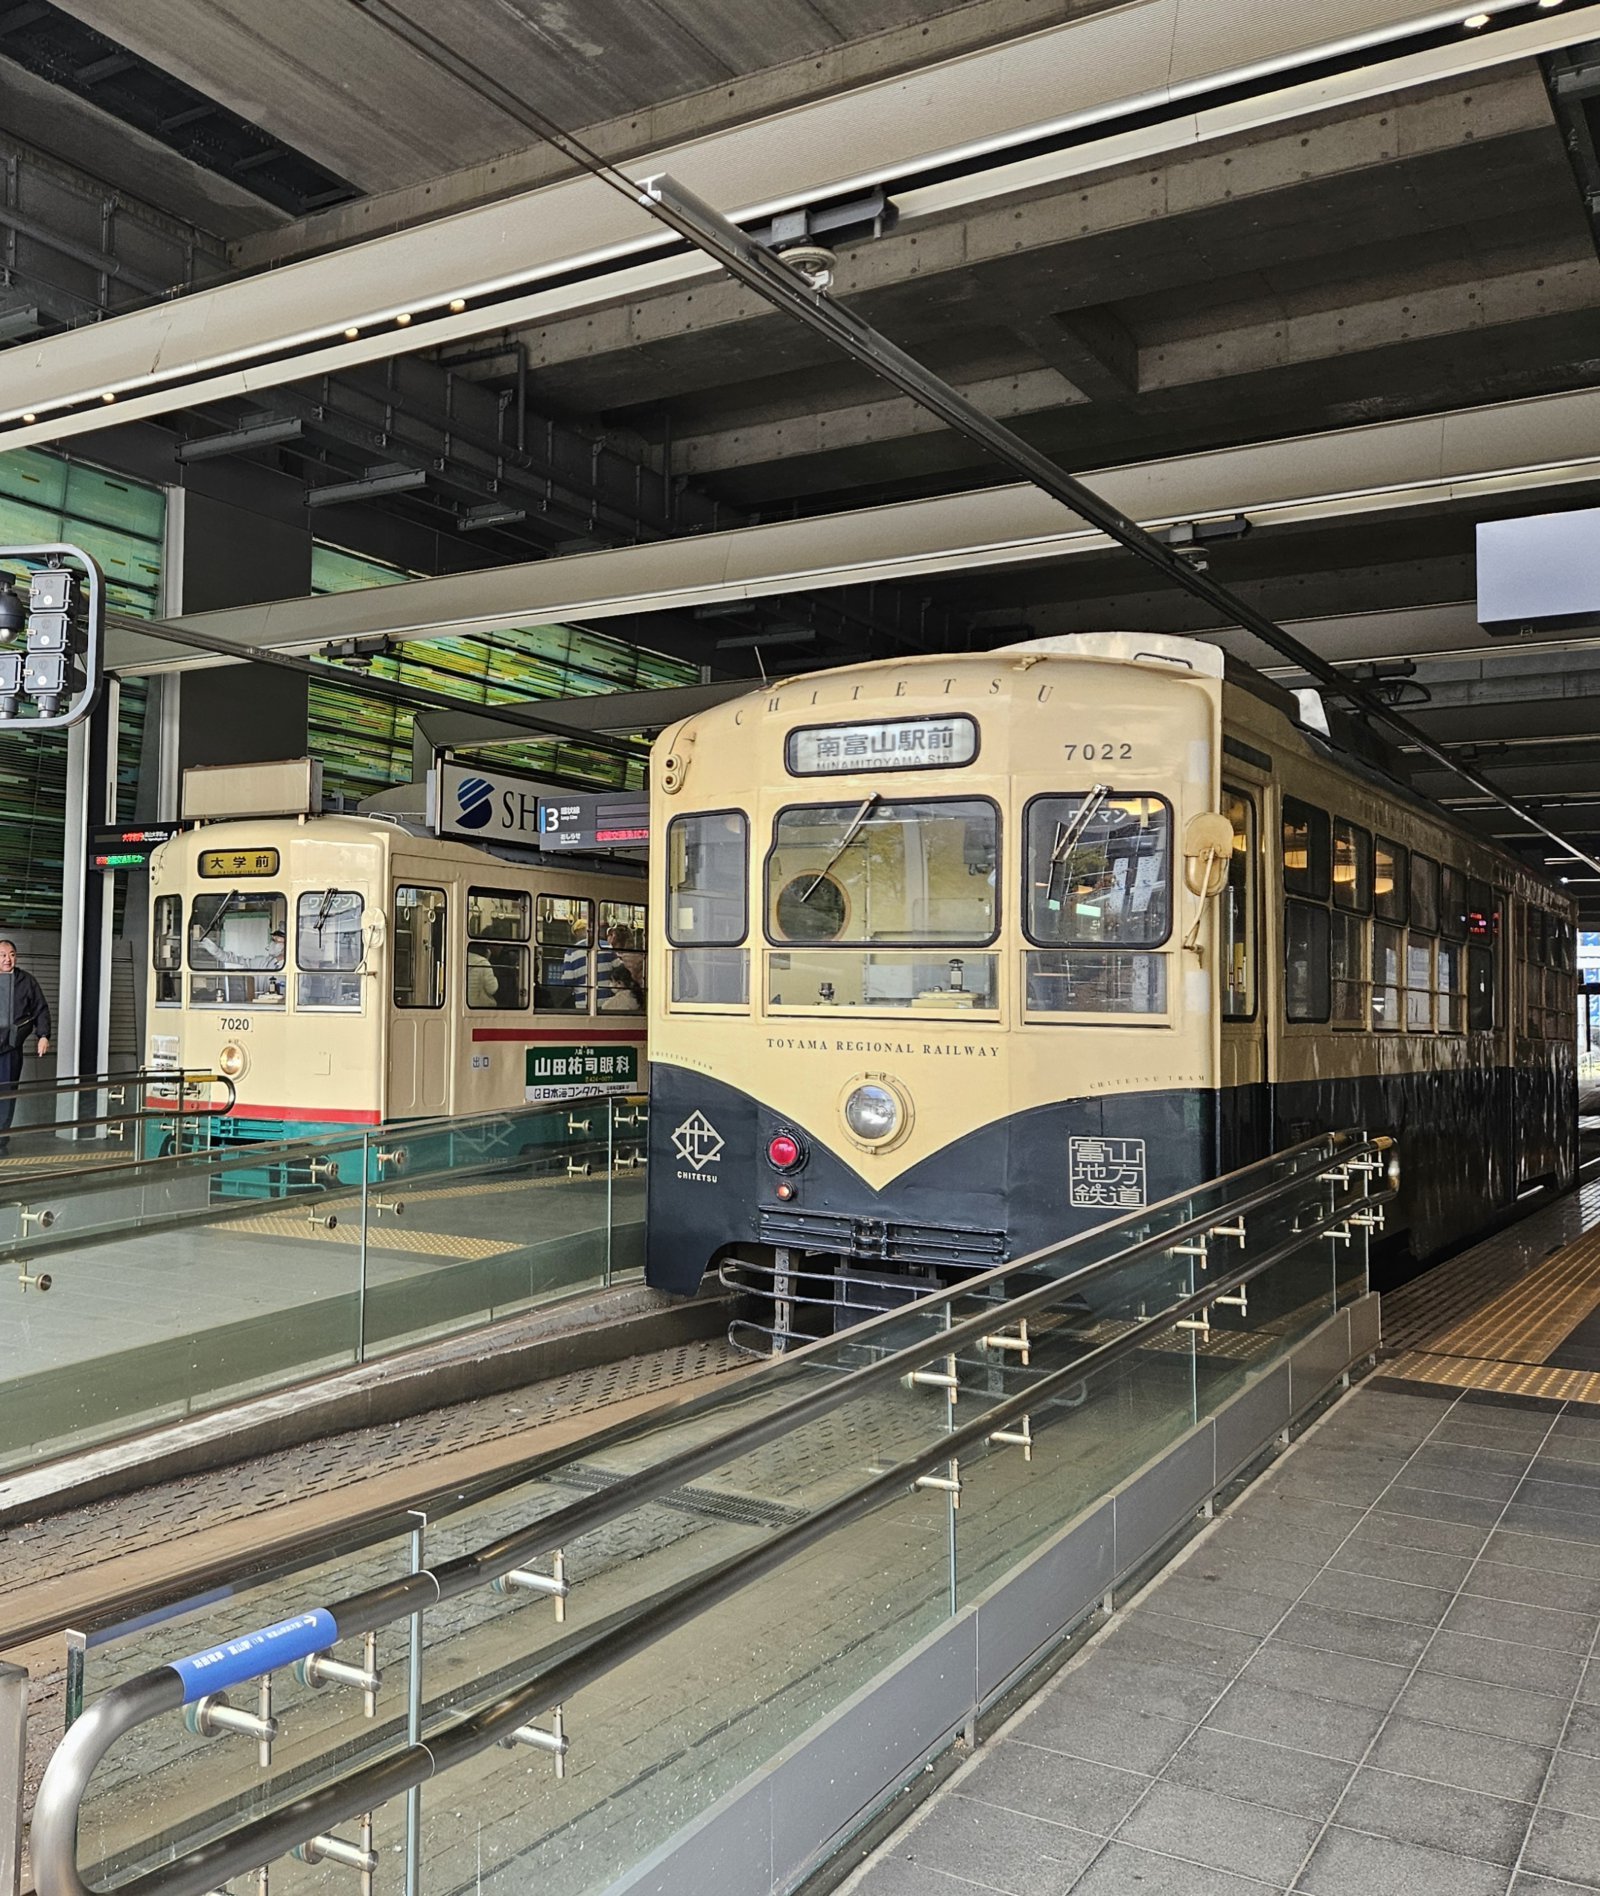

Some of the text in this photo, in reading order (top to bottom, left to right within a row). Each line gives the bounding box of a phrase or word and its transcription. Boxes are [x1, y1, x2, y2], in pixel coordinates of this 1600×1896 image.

[734, 677, 1054, 726] CHITETSU
[815, 725, 955, 759] 南富山駅前
[1064, 743, 1133, 761] 7022
[545, 807, 560, 832] 3
[210, 854, 270, 870] 大学前
[220, 1018, 250, 1031] 7020
[766, 1038, 1000, 1057] TOYAMA REGIONAL RAILWAY
[472, 1056, 489, 1068] 出口
[534, 1055, 630, 1077] 山田祐司眼科
[1089, 1074, 1205, 1089] CHITETSU TRAM
[542, 1086, 604, 1100] 日本海コンタクト
[677, 1170, 718, 1183] CHITETSU
[1071, 1162, 1144, 1185] 地方
